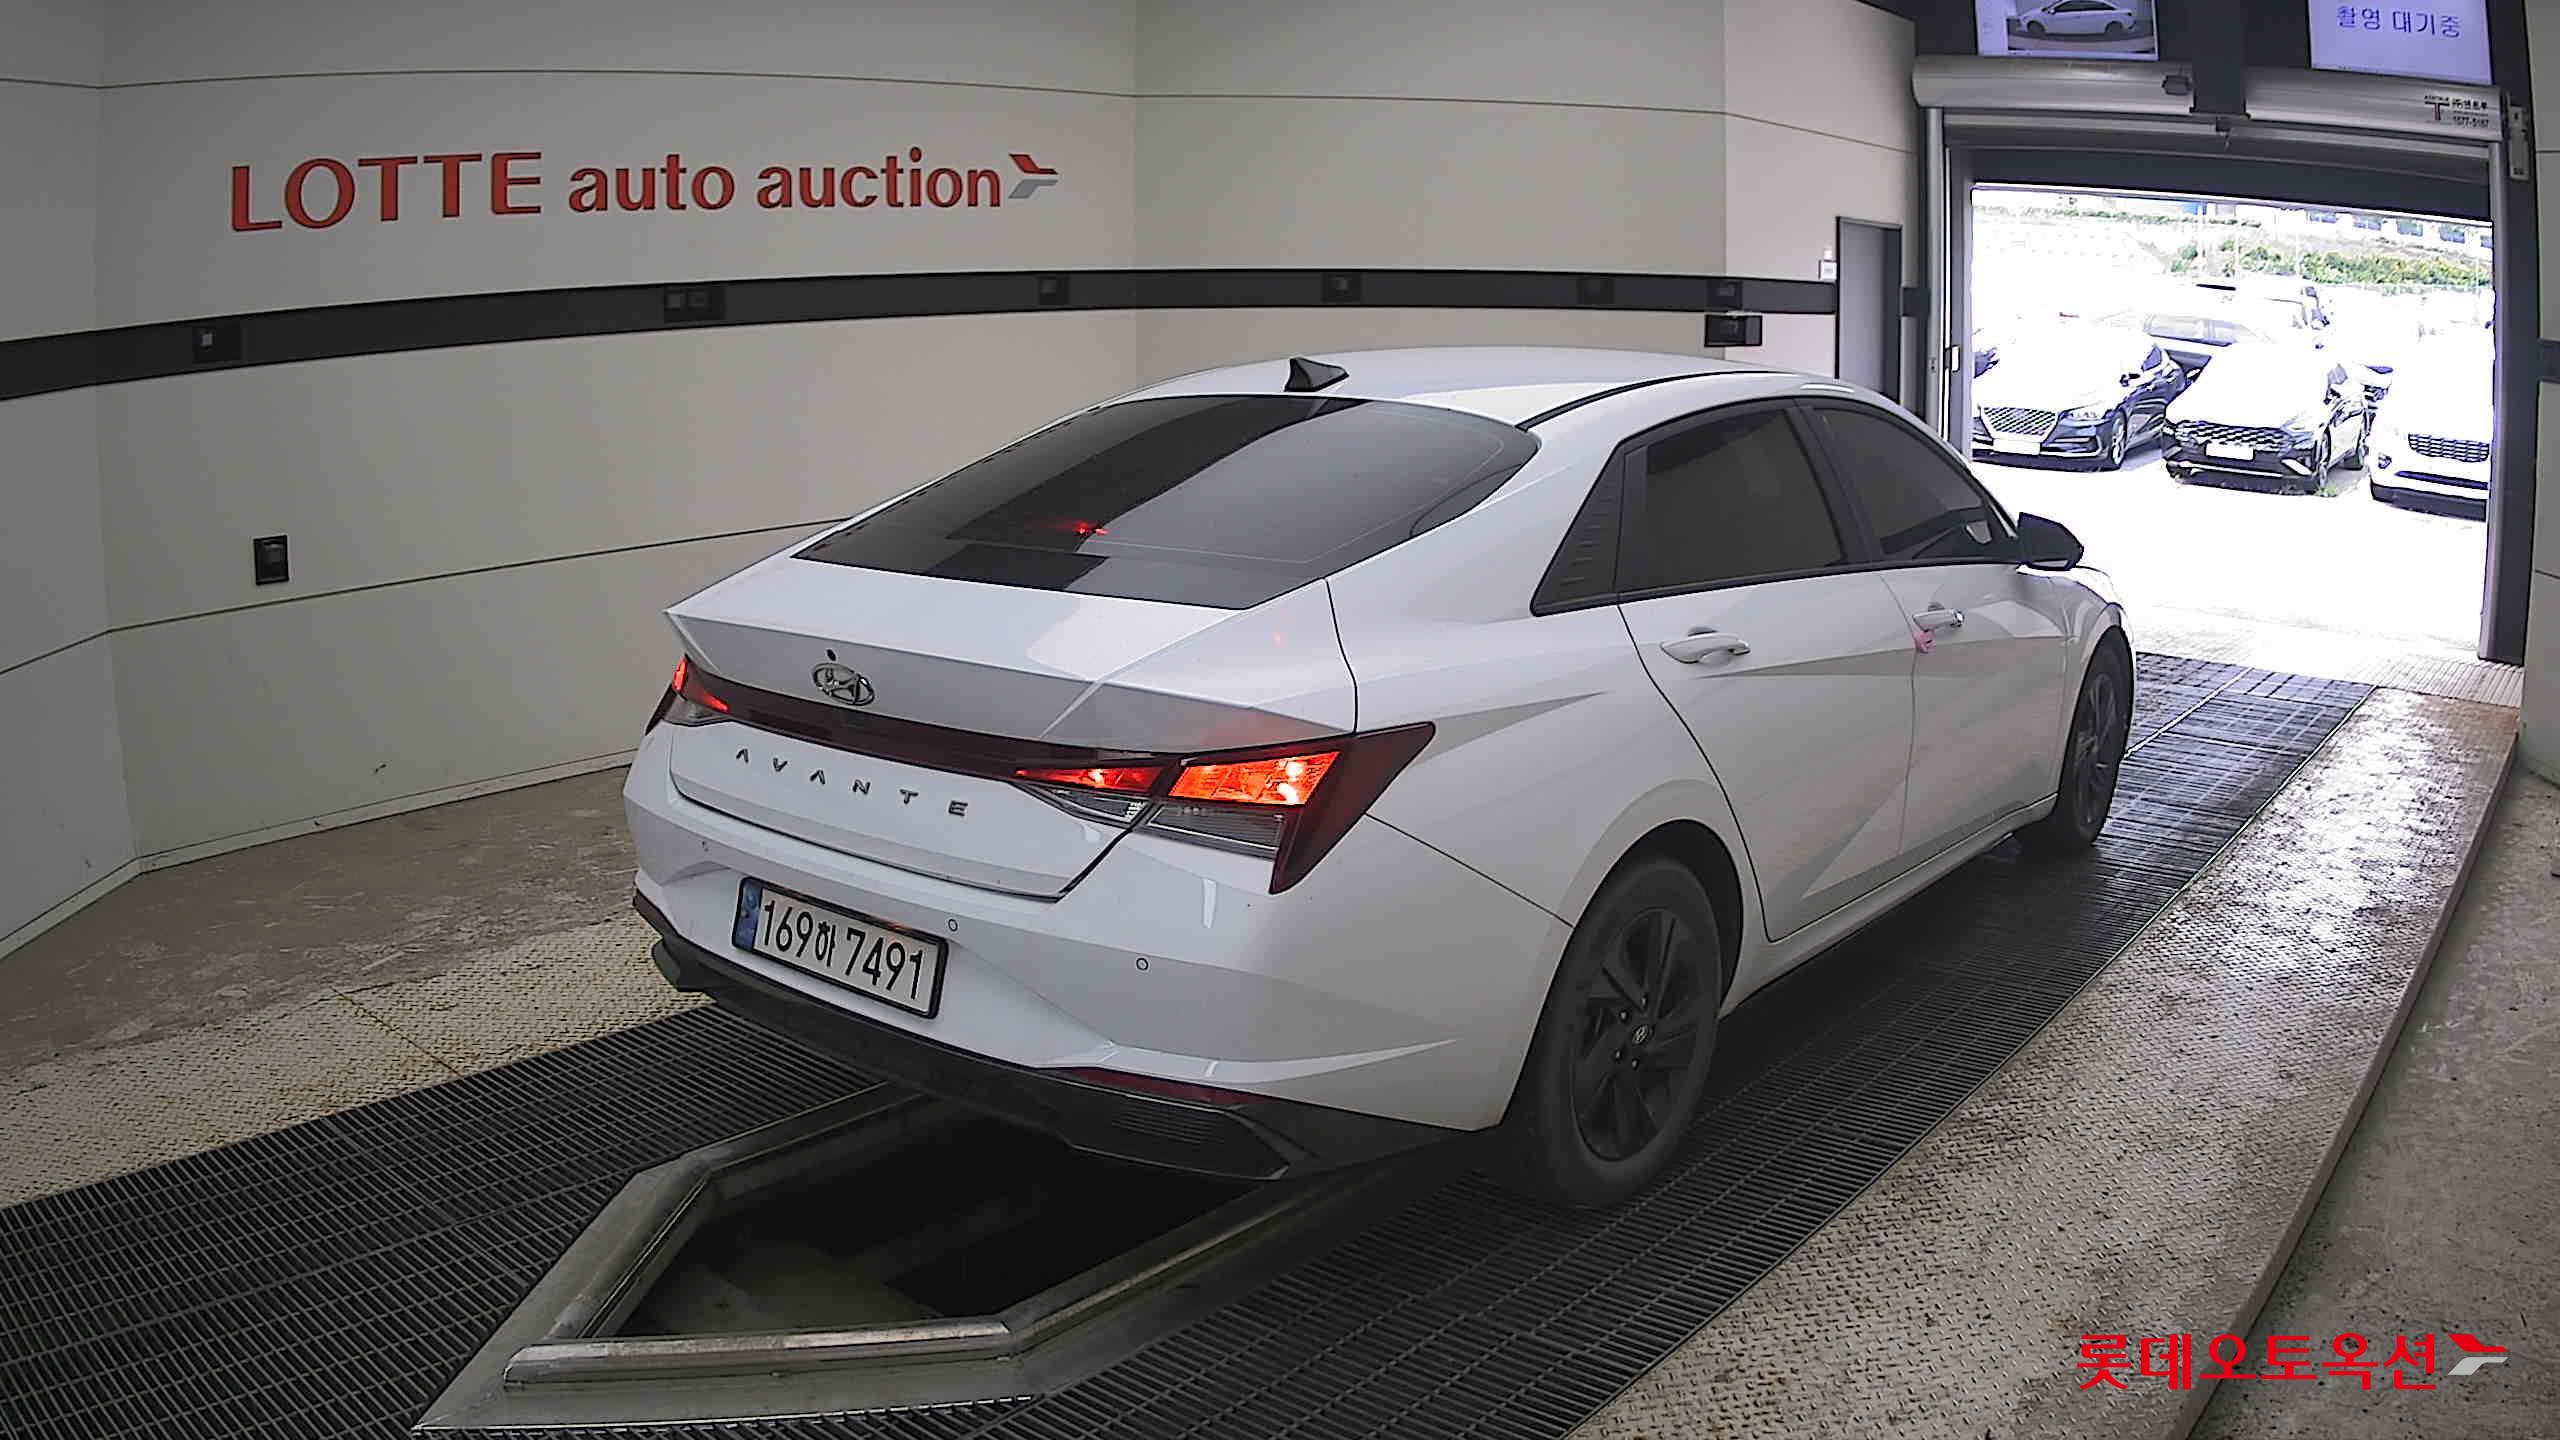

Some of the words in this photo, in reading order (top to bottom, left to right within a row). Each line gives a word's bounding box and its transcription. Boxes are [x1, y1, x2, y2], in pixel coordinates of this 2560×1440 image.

[2338, 6, 2381, 31] 촬영
[2392, 11, 2461, 39] 대기중
[231, 151, 543, 232] LOTTE
[568, 154, 736, 213] auto
[756, 147, 1002, 208] auction
[735, 748, 969, 817] AVANTE
[764, 899, 837, 968] 169하
[845, 926, 924, 1001] 7491
